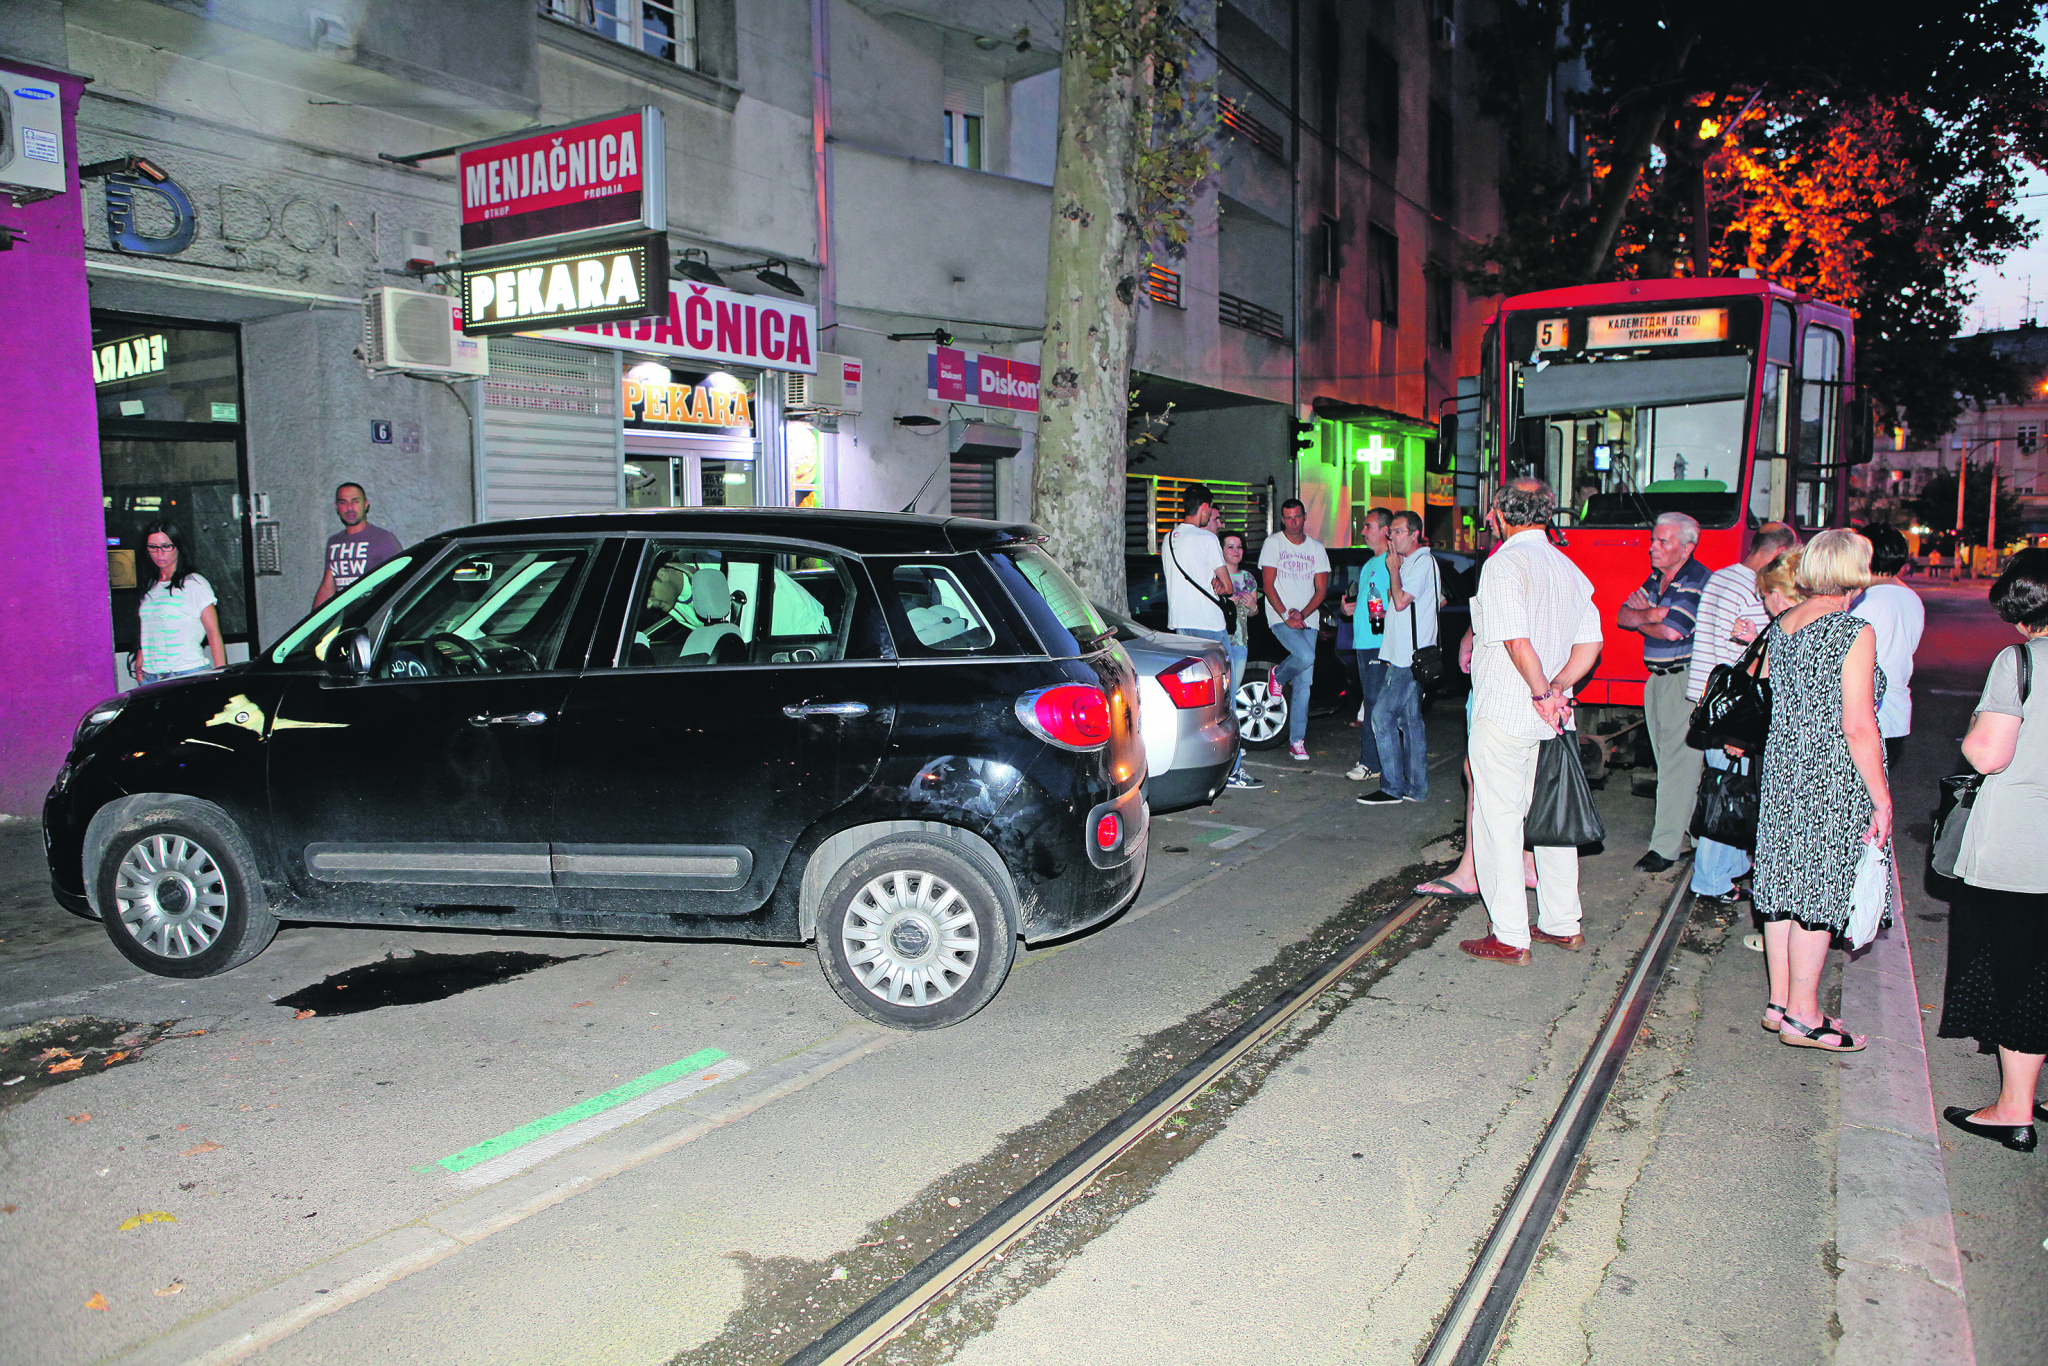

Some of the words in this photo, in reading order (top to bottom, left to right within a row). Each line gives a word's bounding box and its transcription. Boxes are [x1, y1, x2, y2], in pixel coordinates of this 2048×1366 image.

[466, 130, 638, 209] MENJAČNICA
[584, 183, 623, 200] PRODAJA
[484, 205, 510, 219] OTKUP
[471, 255, 641, 322] PEKARA
[560, 284, 812, 366] AČNICA
[1607, 315, 1668, 330] КАЛЕМЕГДАН
[1671, 315, 1701, 327] (БЕКО)
[1541, 323, 1553, 346] 5
[1628, 327, 1680, 340] УСТАНИЧКА
[622, 376, 754, 429] PEKARA
[379, 424, 387, 440] 6
[329, 541, 370, 560] THE
[329, 559, 368, 577] NEW
